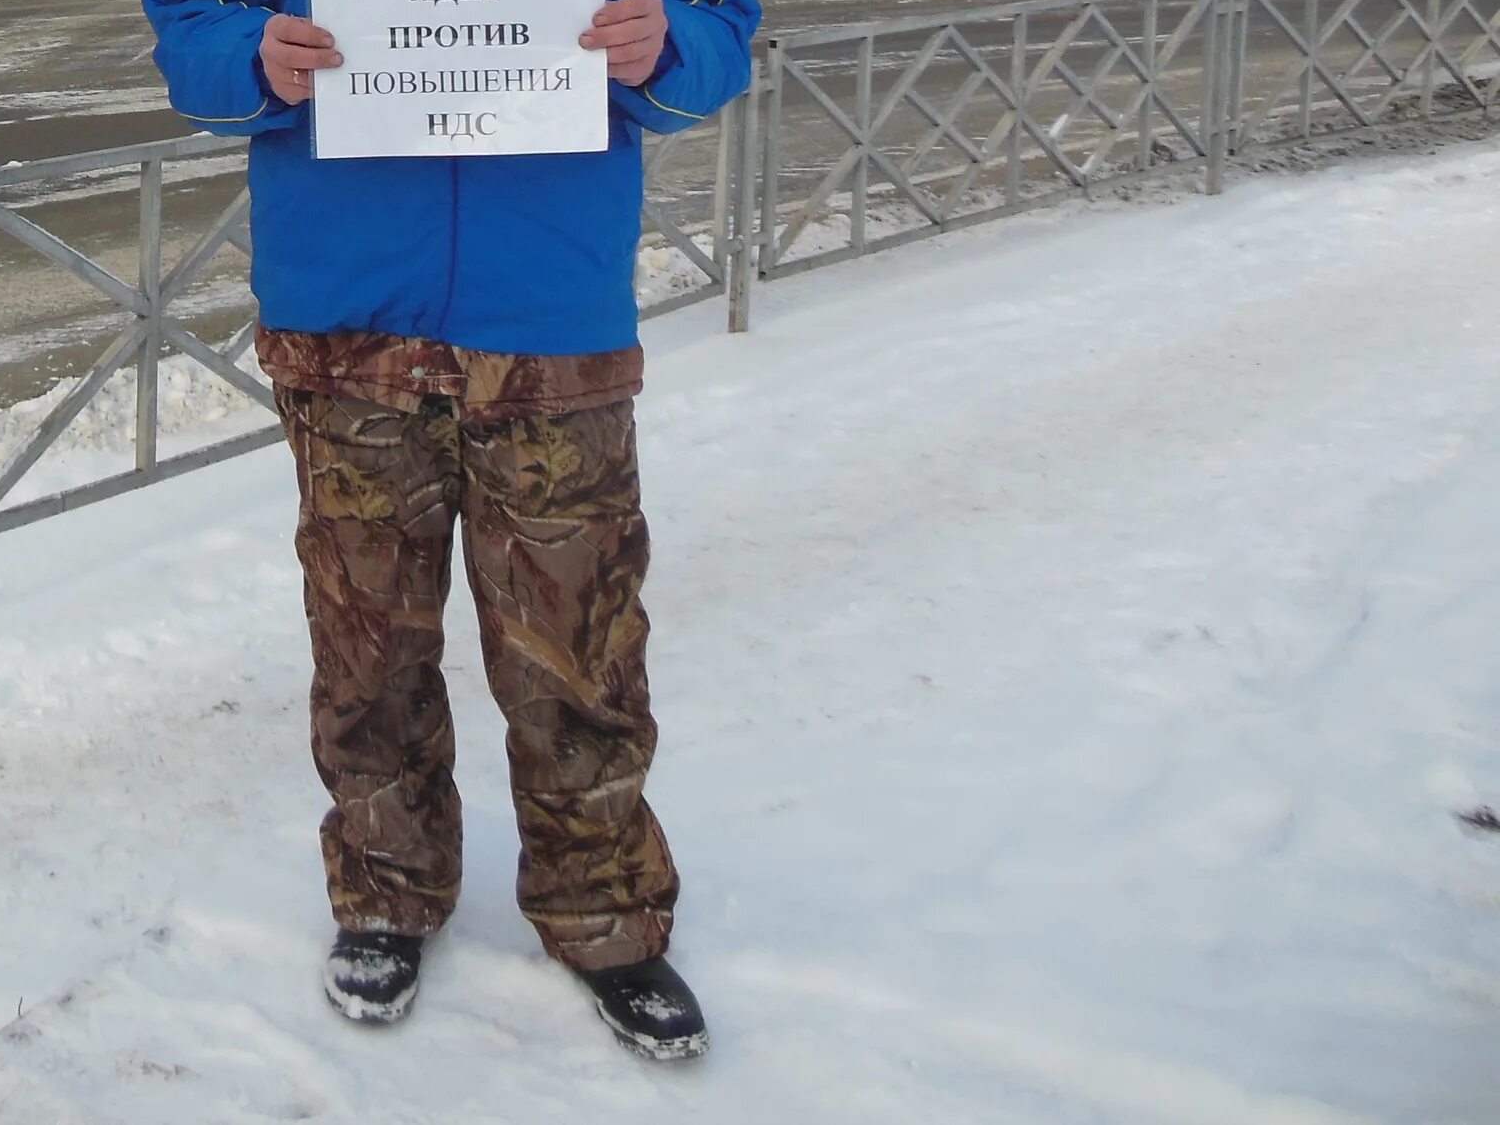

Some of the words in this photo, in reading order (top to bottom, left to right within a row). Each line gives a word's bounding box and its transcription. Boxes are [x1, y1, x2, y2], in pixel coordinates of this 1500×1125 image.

[388, 22, 531, 50] ПРОТИВ
[349, 67, 573, 96] ПОВЫШЕНИЯ
[426, 112, 498, 142] НДС
